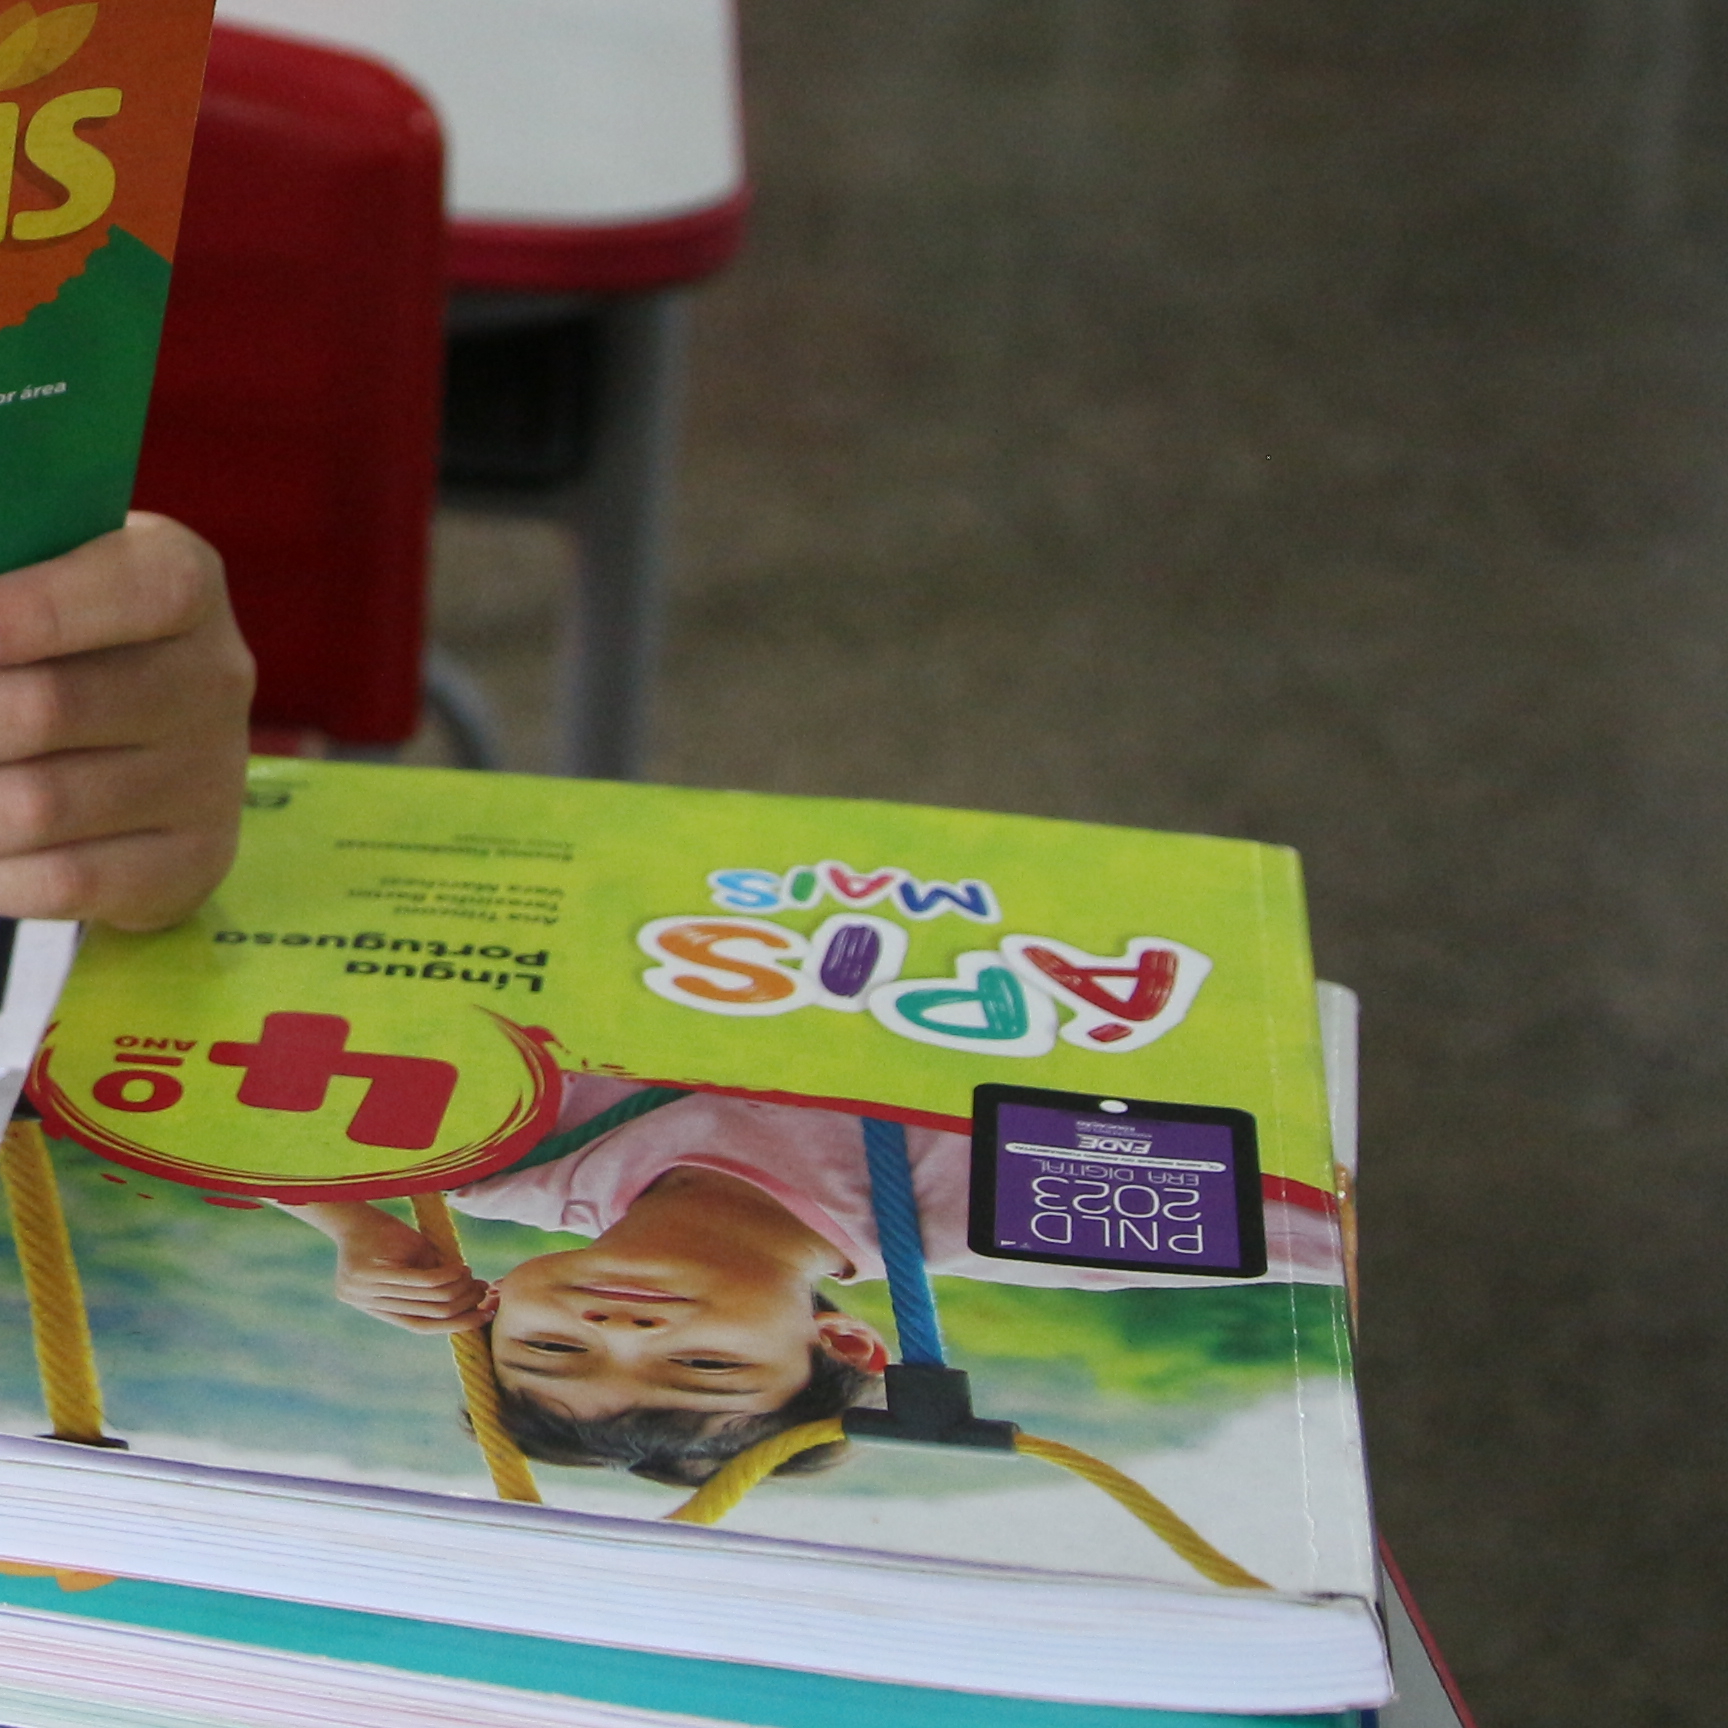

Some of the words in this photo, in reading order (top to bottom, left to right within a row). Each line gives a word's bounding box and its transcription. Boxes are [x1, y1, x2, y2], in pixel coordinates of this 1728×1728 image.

[20, 379, 67, 401] área
[715, 866, 990, 918] MAIS
[213, 929, 552, 968] Portuguesa
[345, 959, 544, 993] Língua
[655, 922, 1179, 1044] ÁPIS
[114, 1034, 198, 1052] ANO
[1030, 1157, 1135, 1182] DIGITAL
[1147, 1171, 1200, 1187] ERA
[1031, 1175, 1202, 1222] 2023
[1030, 1211, 1204, 1255] PNLD
